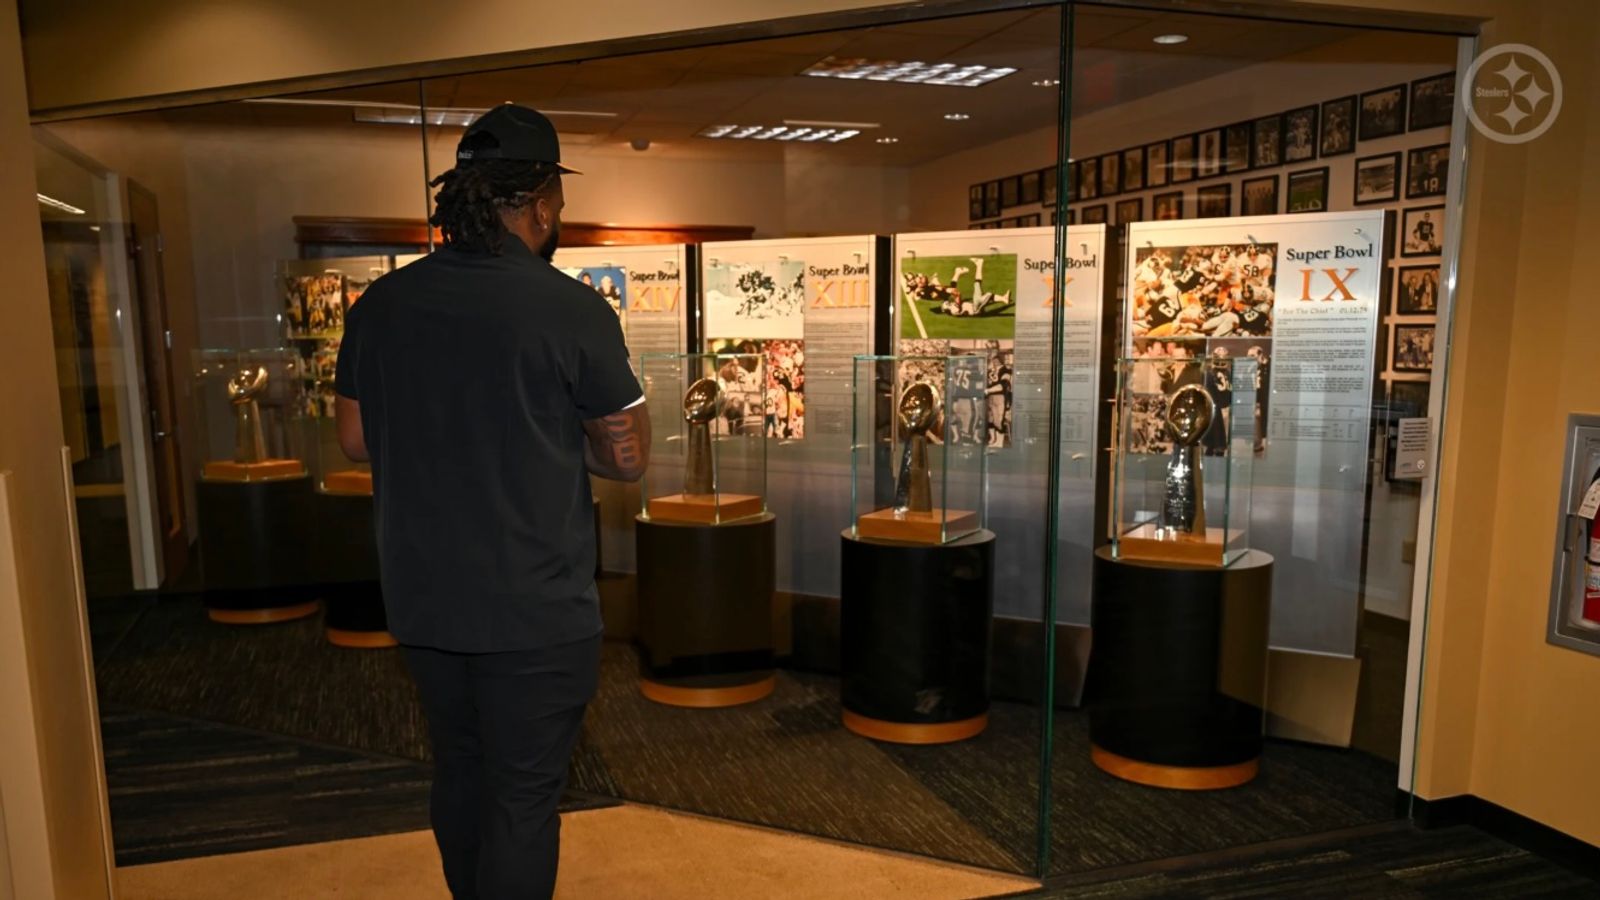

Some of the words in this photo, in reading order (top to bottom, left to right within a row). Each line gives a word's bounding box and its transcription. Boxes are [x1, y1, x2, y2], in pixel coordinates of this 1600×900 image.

[1024, 258, 1055, 273] Supe
[1065, 254, 1096, 269] Bowl
[1286, 248, 1330, 264] Super
[1334, 243, 1373, 259] Bowl
[629, 270, 656, 283] Super
[657, 269, 680, 281] Bowl
[809, 265, 840, 279] Super
[843, 263, 869, 276] Bowl
[809, 280, 871, 309] XIII
[1299, 267, 1360, 302] IX
[629, 286, 681, 312] XIV
[955, 369, 971, 390] 75
